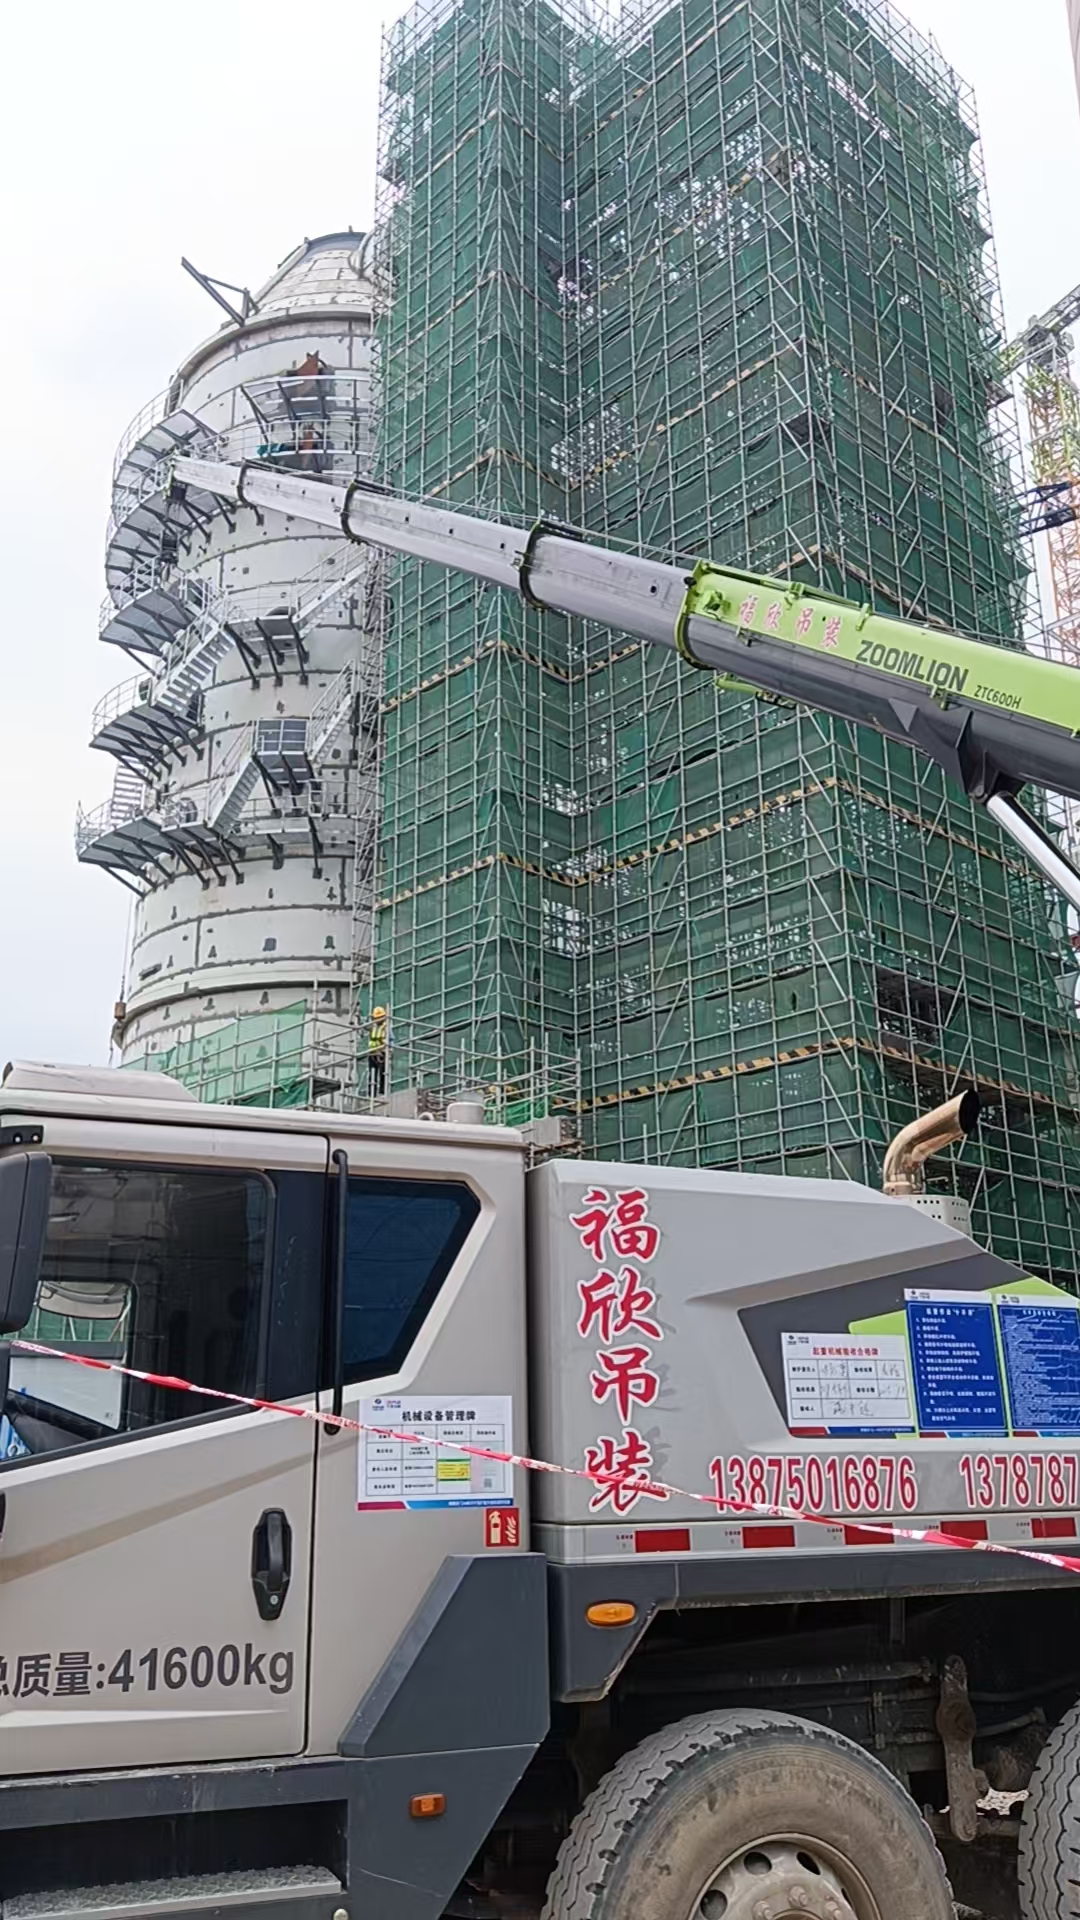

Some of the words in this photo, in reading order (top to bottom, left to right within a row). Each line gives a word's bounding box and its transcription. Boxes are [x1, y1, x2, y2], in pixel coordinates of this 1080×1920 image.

[738, 592, 842, 650] 福欣吊装
[855, 639, 969, 692] ZOOMLION
[974, 684, 1022, 710] ZTC600H
[569, 1185, 670, 1517] 福欣吊装
[401, 1409, 477, 1422] 机械设备管理牌
[709, 1455, 918, 1514] 13875016876
[0, 1643, 294, 1698] 质量:41600kg
